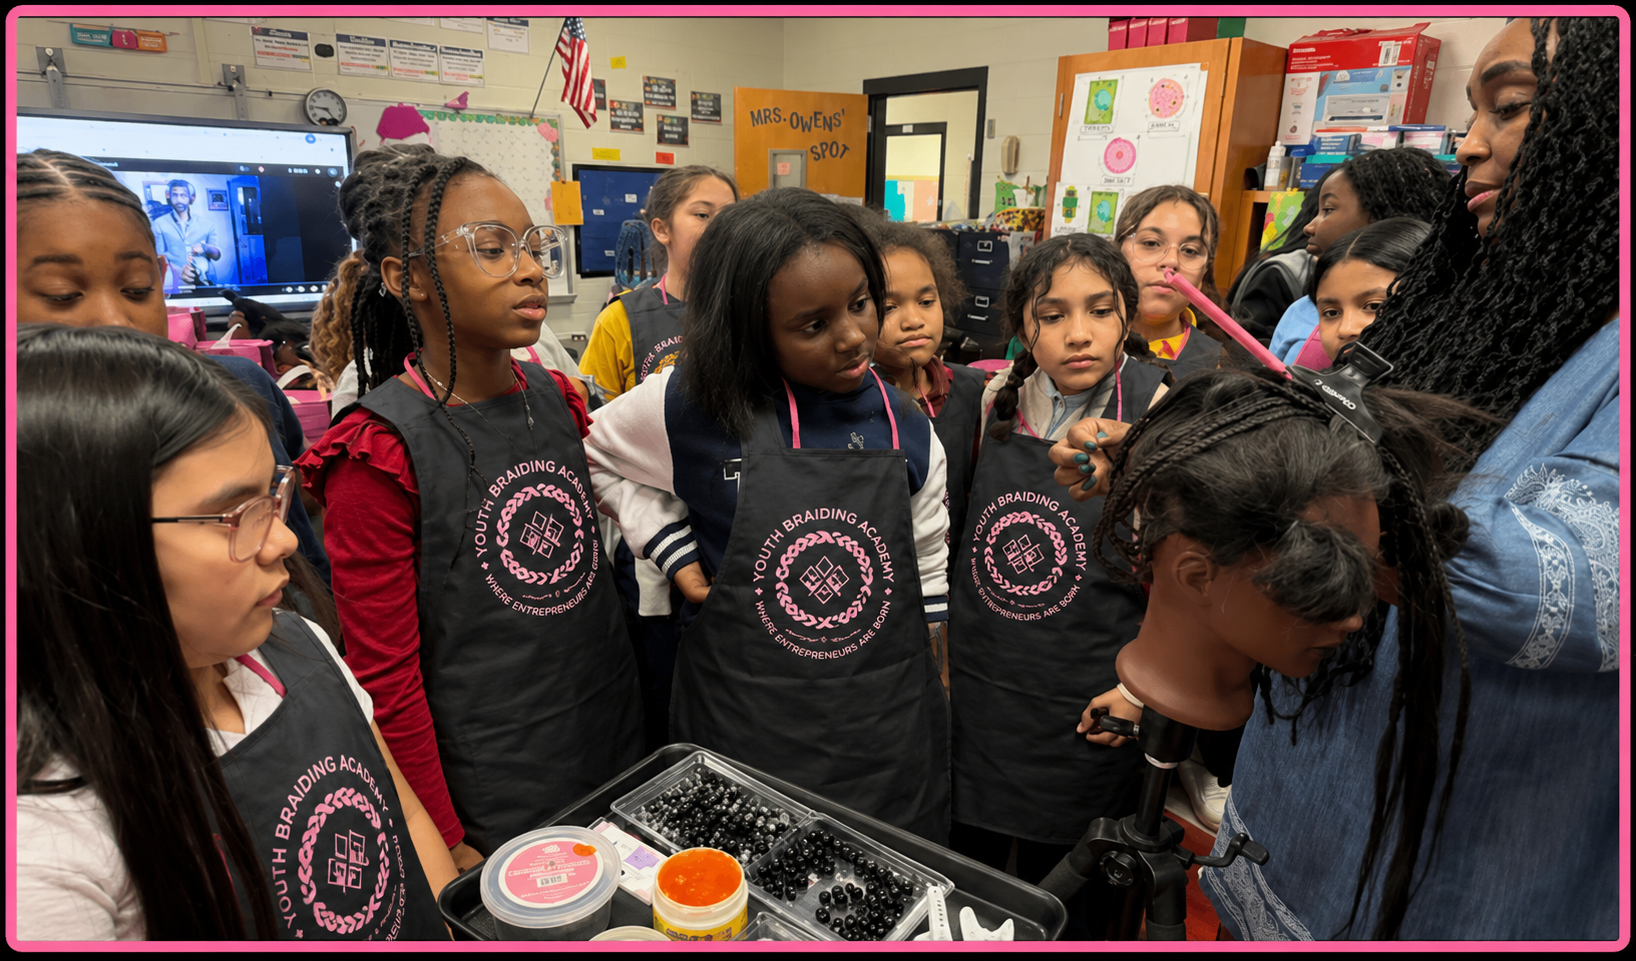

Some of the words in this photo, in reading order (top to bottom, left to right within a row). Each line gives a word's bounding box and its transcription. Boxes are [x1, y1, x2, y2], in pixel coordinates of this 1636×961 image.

[750, 107, 787, 127] MRS.
[789, 108, 845, 133] OWENS'
[810, 140, 850, 161] SPOT
[475, 498, 494, 557] YOUTH
[488, 460, 556, 498] BRAIDING
[558, 465, 593, 520] ACADEMY
[973, 502, 997, 542] YOUTH
[997, 491, 1059, 511] BRAIDING
[1058, 510, 1087, 571] ACADEMY
[753, 529, 784, 582] YOUTH
[782, 508, 857, 532] BRAIDING
[857, 521, 894, 582] ACADEMY
[485, 573, 513, 605] WHERE
[1044, 604, 1061, 618] ARE
[755, 600, 777, 635] WHERE
[774, 634, 858, 660] ENTREPRENEURS
[859, 628, 876, 646] ARE
[873, 600, 891, 629] BORN
[275, 756, 336, 840] BRAIDING
[339, 754, 388, 812] ACADEMY
[272, 848, 297, 928] YOUTH
